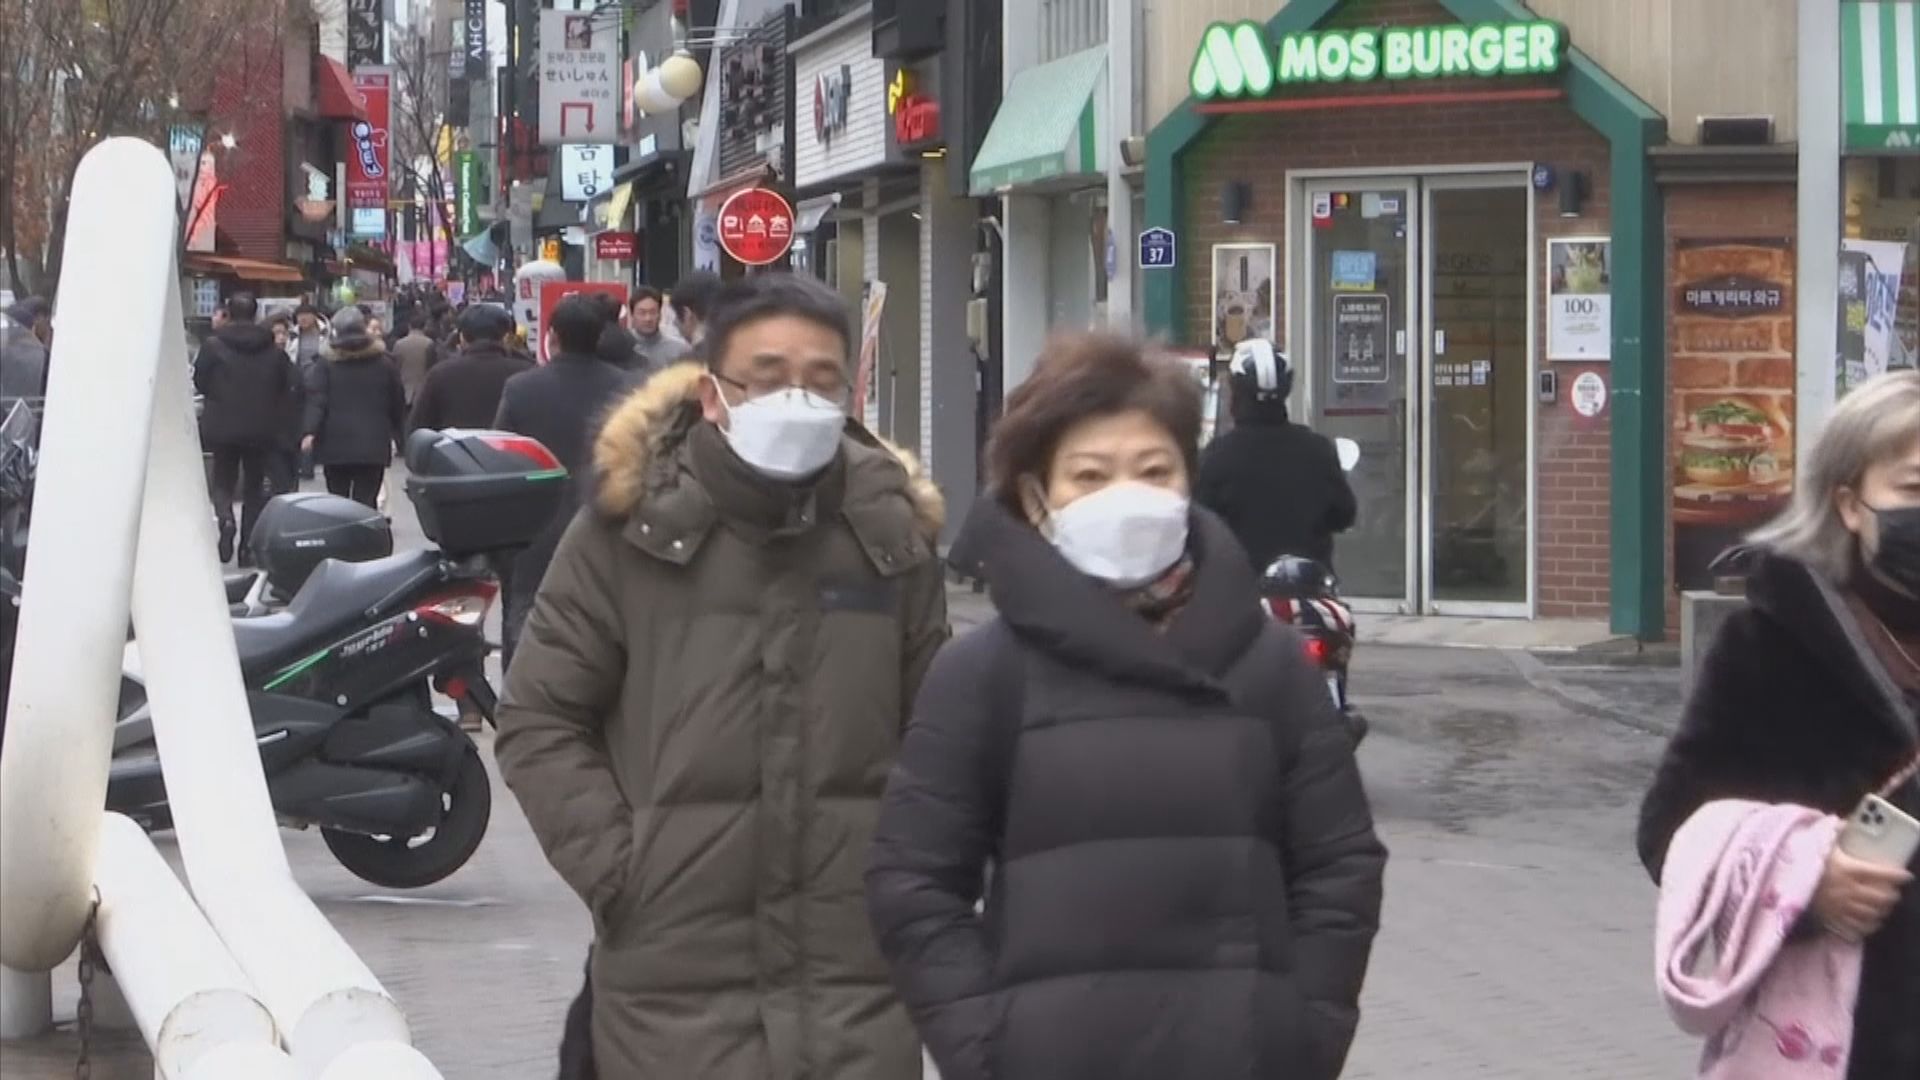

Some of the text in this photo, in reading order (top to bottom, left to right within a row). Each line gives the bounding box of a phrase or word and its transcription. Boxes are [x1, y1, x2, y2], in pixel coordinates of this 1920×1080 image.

[1280, 24, 1556, 78] MOS BURGER
[544, 68, 609, 82] せいしゅん
[1149, 248, 1164, 263] 37
